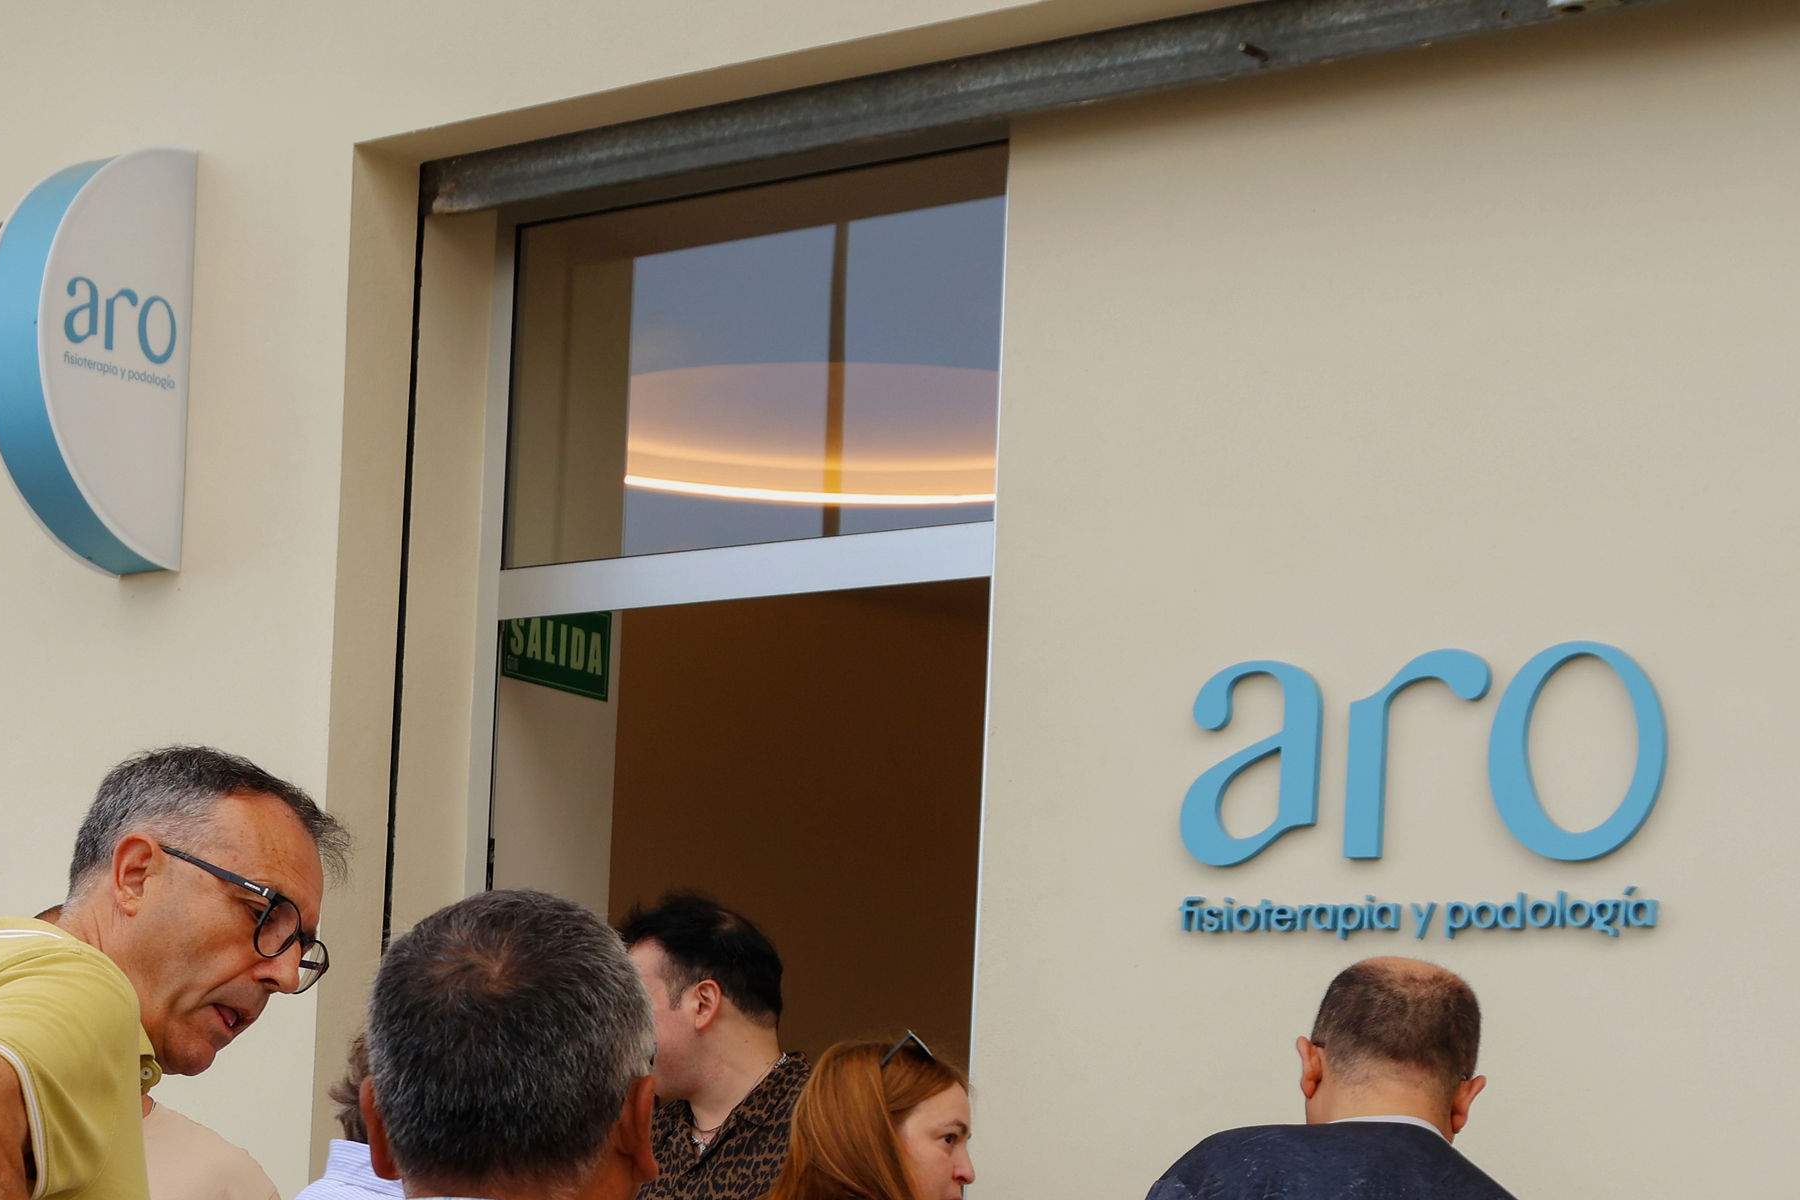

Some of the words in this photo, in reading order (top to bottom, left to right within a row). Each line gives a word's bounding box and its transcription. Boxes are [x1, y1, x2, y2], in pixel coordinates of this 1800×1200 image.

[63, 276, 177, 364] aro
[64, 351, 118, 376] fisioterapia
[127, 368, 175, 390] podología
[510, 617, 602, 676] SALIDA
[1180, 641, 1668, 867] aro
[1179, 895, 1401, 940] fisioterapia
[1411, 901, 1438, 939] y
[1444, 886, 1659, 940] podología
